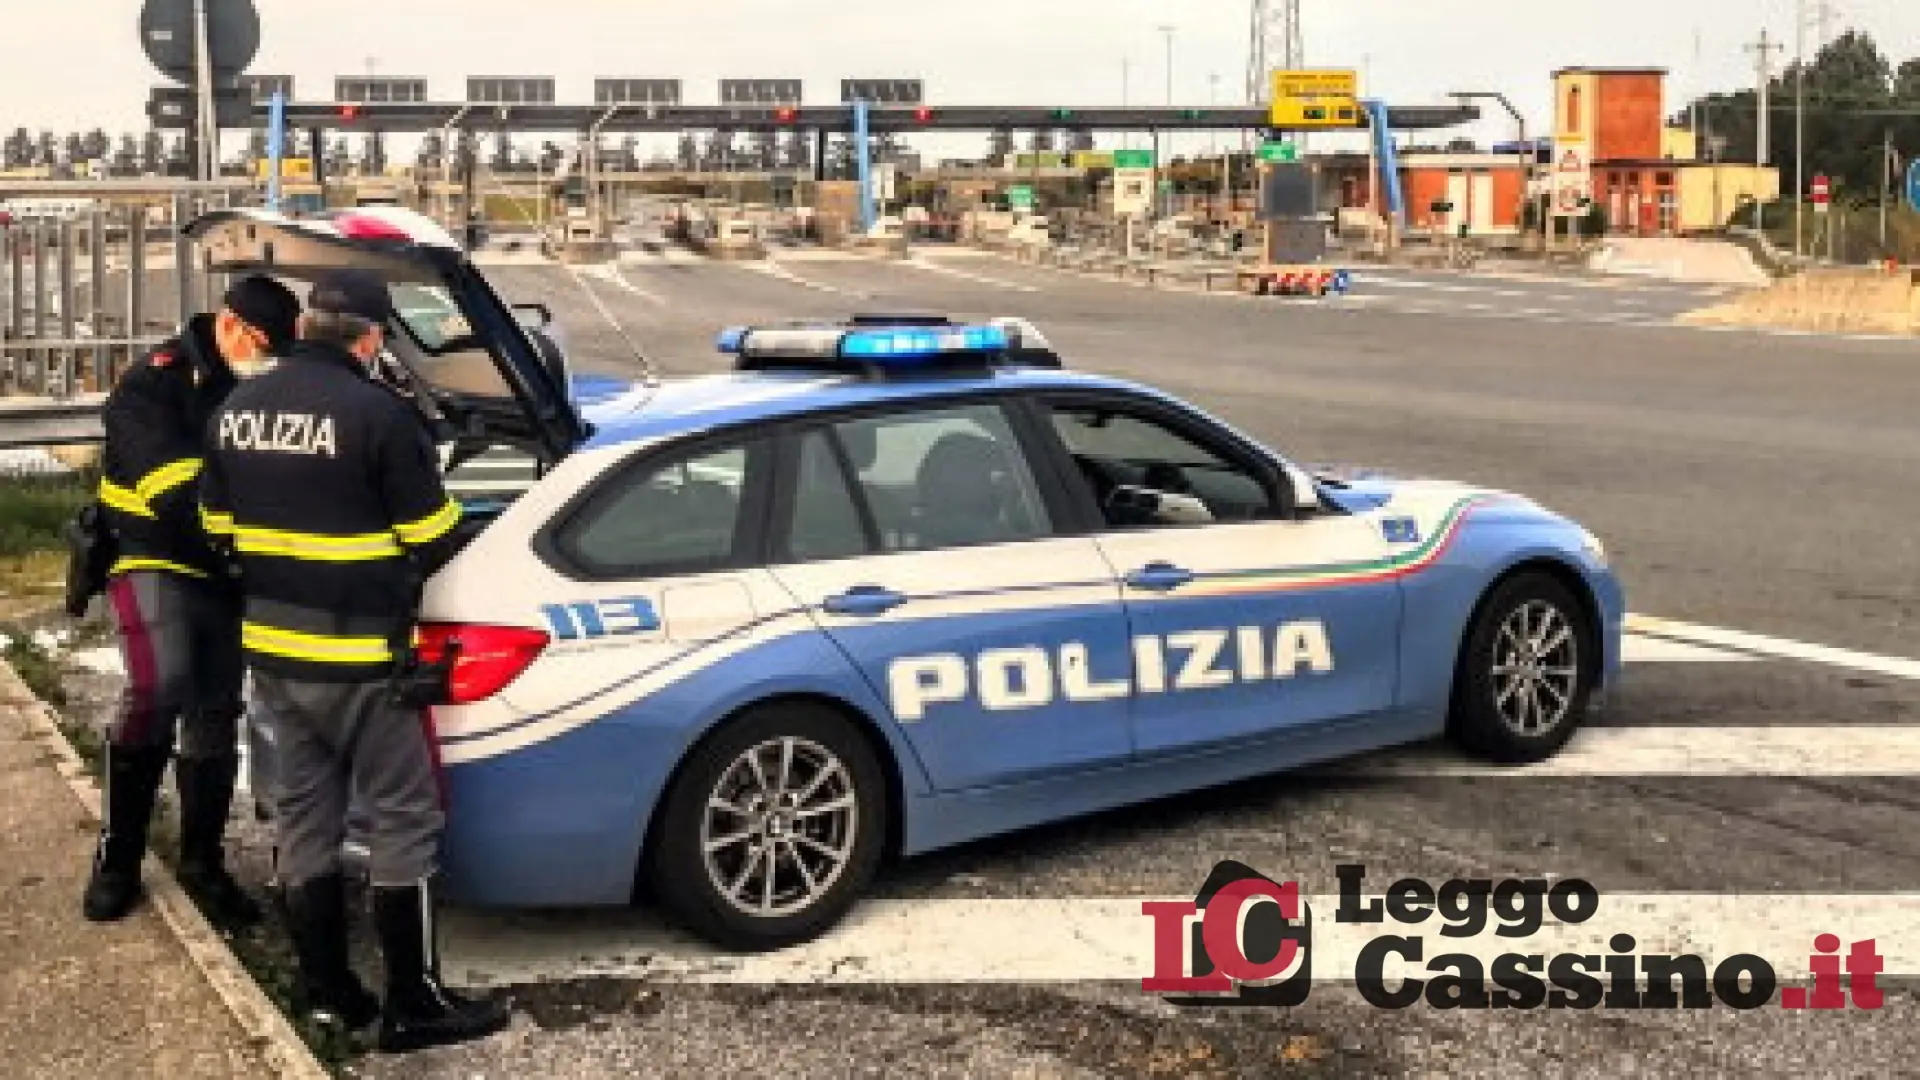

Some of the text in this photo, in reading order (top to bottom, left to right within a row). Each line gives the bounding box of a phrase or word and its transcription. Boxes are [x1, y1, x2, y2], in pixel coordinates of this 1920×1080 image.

[219, 409, 336, 459] POLIZIA
[541, 596, 661, 640] 113
[888, 617, 1335, 723] POLIZIA
